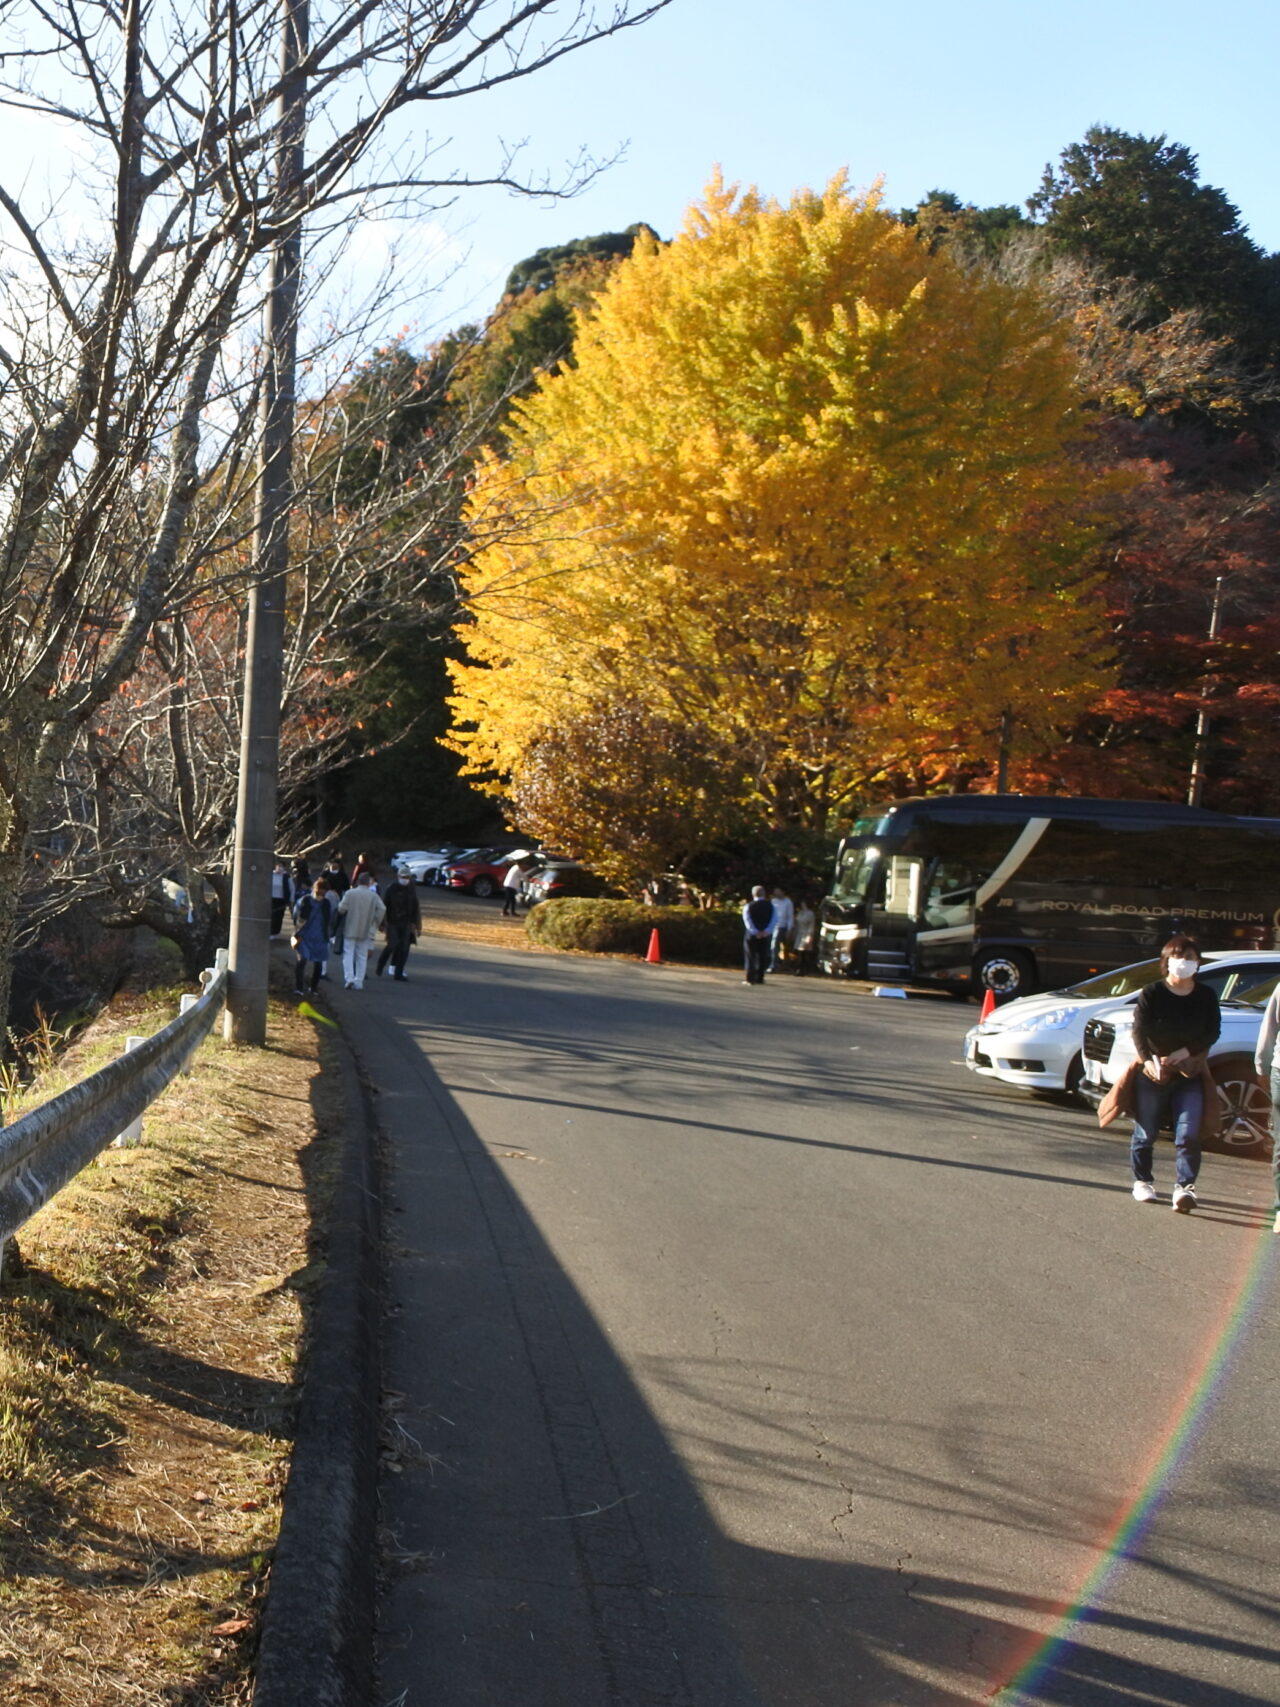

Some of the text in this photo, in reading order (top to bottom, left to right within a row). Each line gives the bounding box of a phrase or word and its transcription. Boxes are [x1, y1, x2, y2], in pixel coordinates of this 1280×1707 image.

[1041, 900, 1264, 922] ROYAL ROAD PREMIUM
